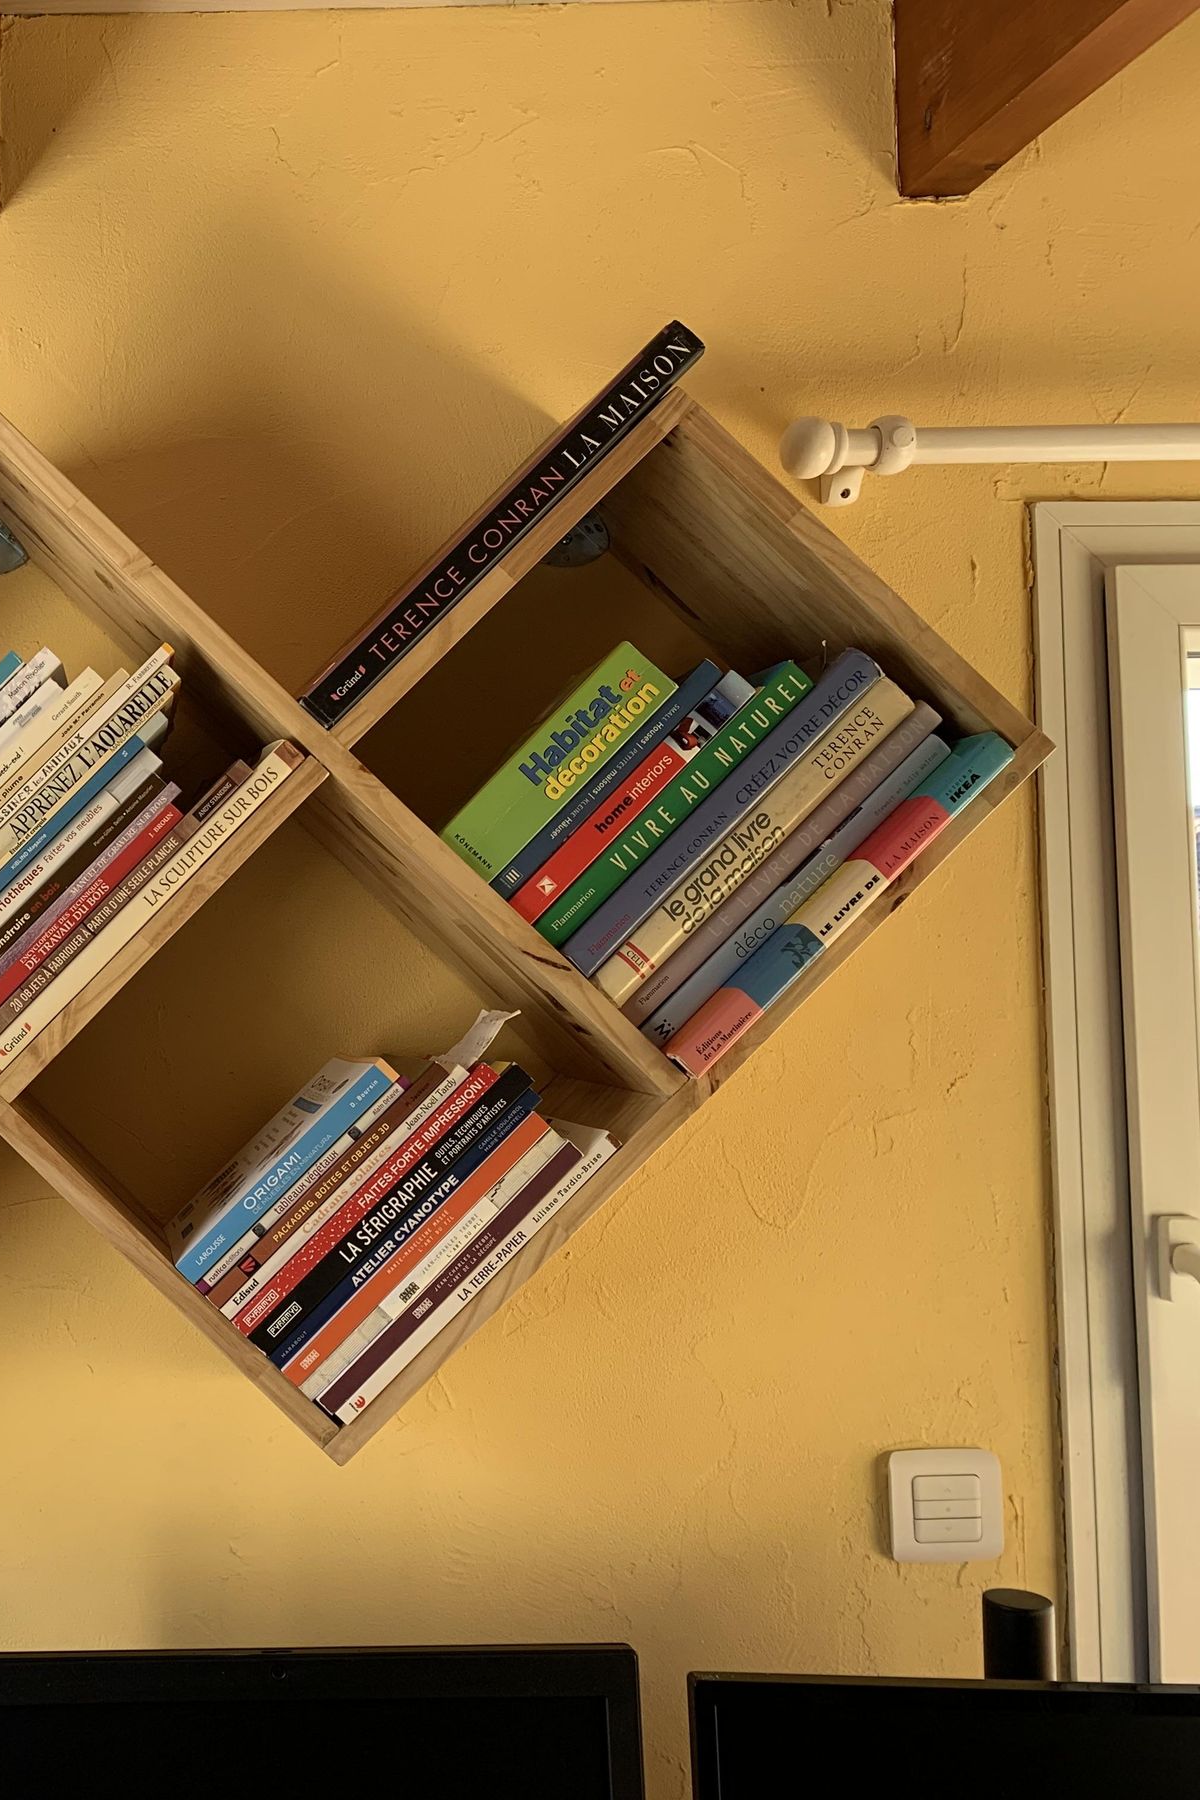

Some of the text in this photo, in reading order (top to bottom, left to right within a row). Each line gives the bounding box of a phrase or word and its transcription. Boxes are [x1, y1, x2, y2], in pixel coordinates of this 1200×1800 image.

[367, 334, 694, 664] TERENCE CONRAN LA MAISON
[39, 732, 85, 777] ANIMAUX
[517, 684, 623, 786] Habitat
[544, 682, 661, 801] décoration
[732, 666, 868, 806] CRÉEZ VOTRE DÉCOR
[810, 705, 875, 771] TERENCE
[821, 715, 885, 780] CONRAN
[0, 774, 25, 798] plume
[5, 762, 83, 840] APPRENEZ
[591, 768, 619, 796] maisons
[608, 671, 807, 874] VIVRE AU NATUREL
[948, 771, 981, 804] IKEA
[42, 840, 65, 863] Faites
[74, 802, 103, 831] meubles
[105, 825, 138, 858] GRAVURE
[143, 766, 279, 906] LA SCULPTURE SUR BOIS
[735, 716, 926, 909] LIVRE MAISON
[642, 810, 729, 899] TERENCE CONRAN
[660, 806, 774, 922] le grand livre
[674, 821, 787, 935] de la maison
[832, 812, 940, 922] LIVRE MAISON
[18, 836, 179, 1001] OBJETS FABRIQUER PARTIR SEULE PLANCHE
[37, 882, 110, 956] TRAVAIL BOIS
[68, 877, 104, 913] TECHNIQUES
[550, 884, 596, 931] Flammarion
[729, 850, 840, 960] déco nature
[587, 911, 631, 956] Flammarion
[638, 973, 670, 1006] Flammarion
[2, 1027, 28, 1053] Gründ
[718, 1009, 753, 1044] Martinière
[402, 1075, 458, 1130] Jean-Noël Tardy
[434, 1103, 488, 1159] OUTILS, TECHNIQUES
[447, 1097, 506, 1157] PORTRAITS D'ARTISTES
[241, 1150, 302, 1211] ORIGAMI
[272, 1132, 380, 1242] PACKAGING, BOÎTES OBJETS
[273, 1148, 340, 1215] tableaux végétaux
[300, 1141, 392, 1235] Cadrans solaires
[356, 1138, 425, 1208] FAITES FORTE
[531, 1151, 603, 1223] Liliane Tardio-Brise
[338, 1239, 362, 1263] LA
[351, 1159, 439, 1246] SÉRIGRAPHIE
[348, 1173, 460, 1287] ATELIER CYANOTYPE
[194, 1233, 226, 1265] LAROUSSE
[468, 1230, 527, 1289] TERRE-PAPIER
[231, 1277, 260, 1306] Edisud
[268, 1303, 300, 1335] PYRAMYD
